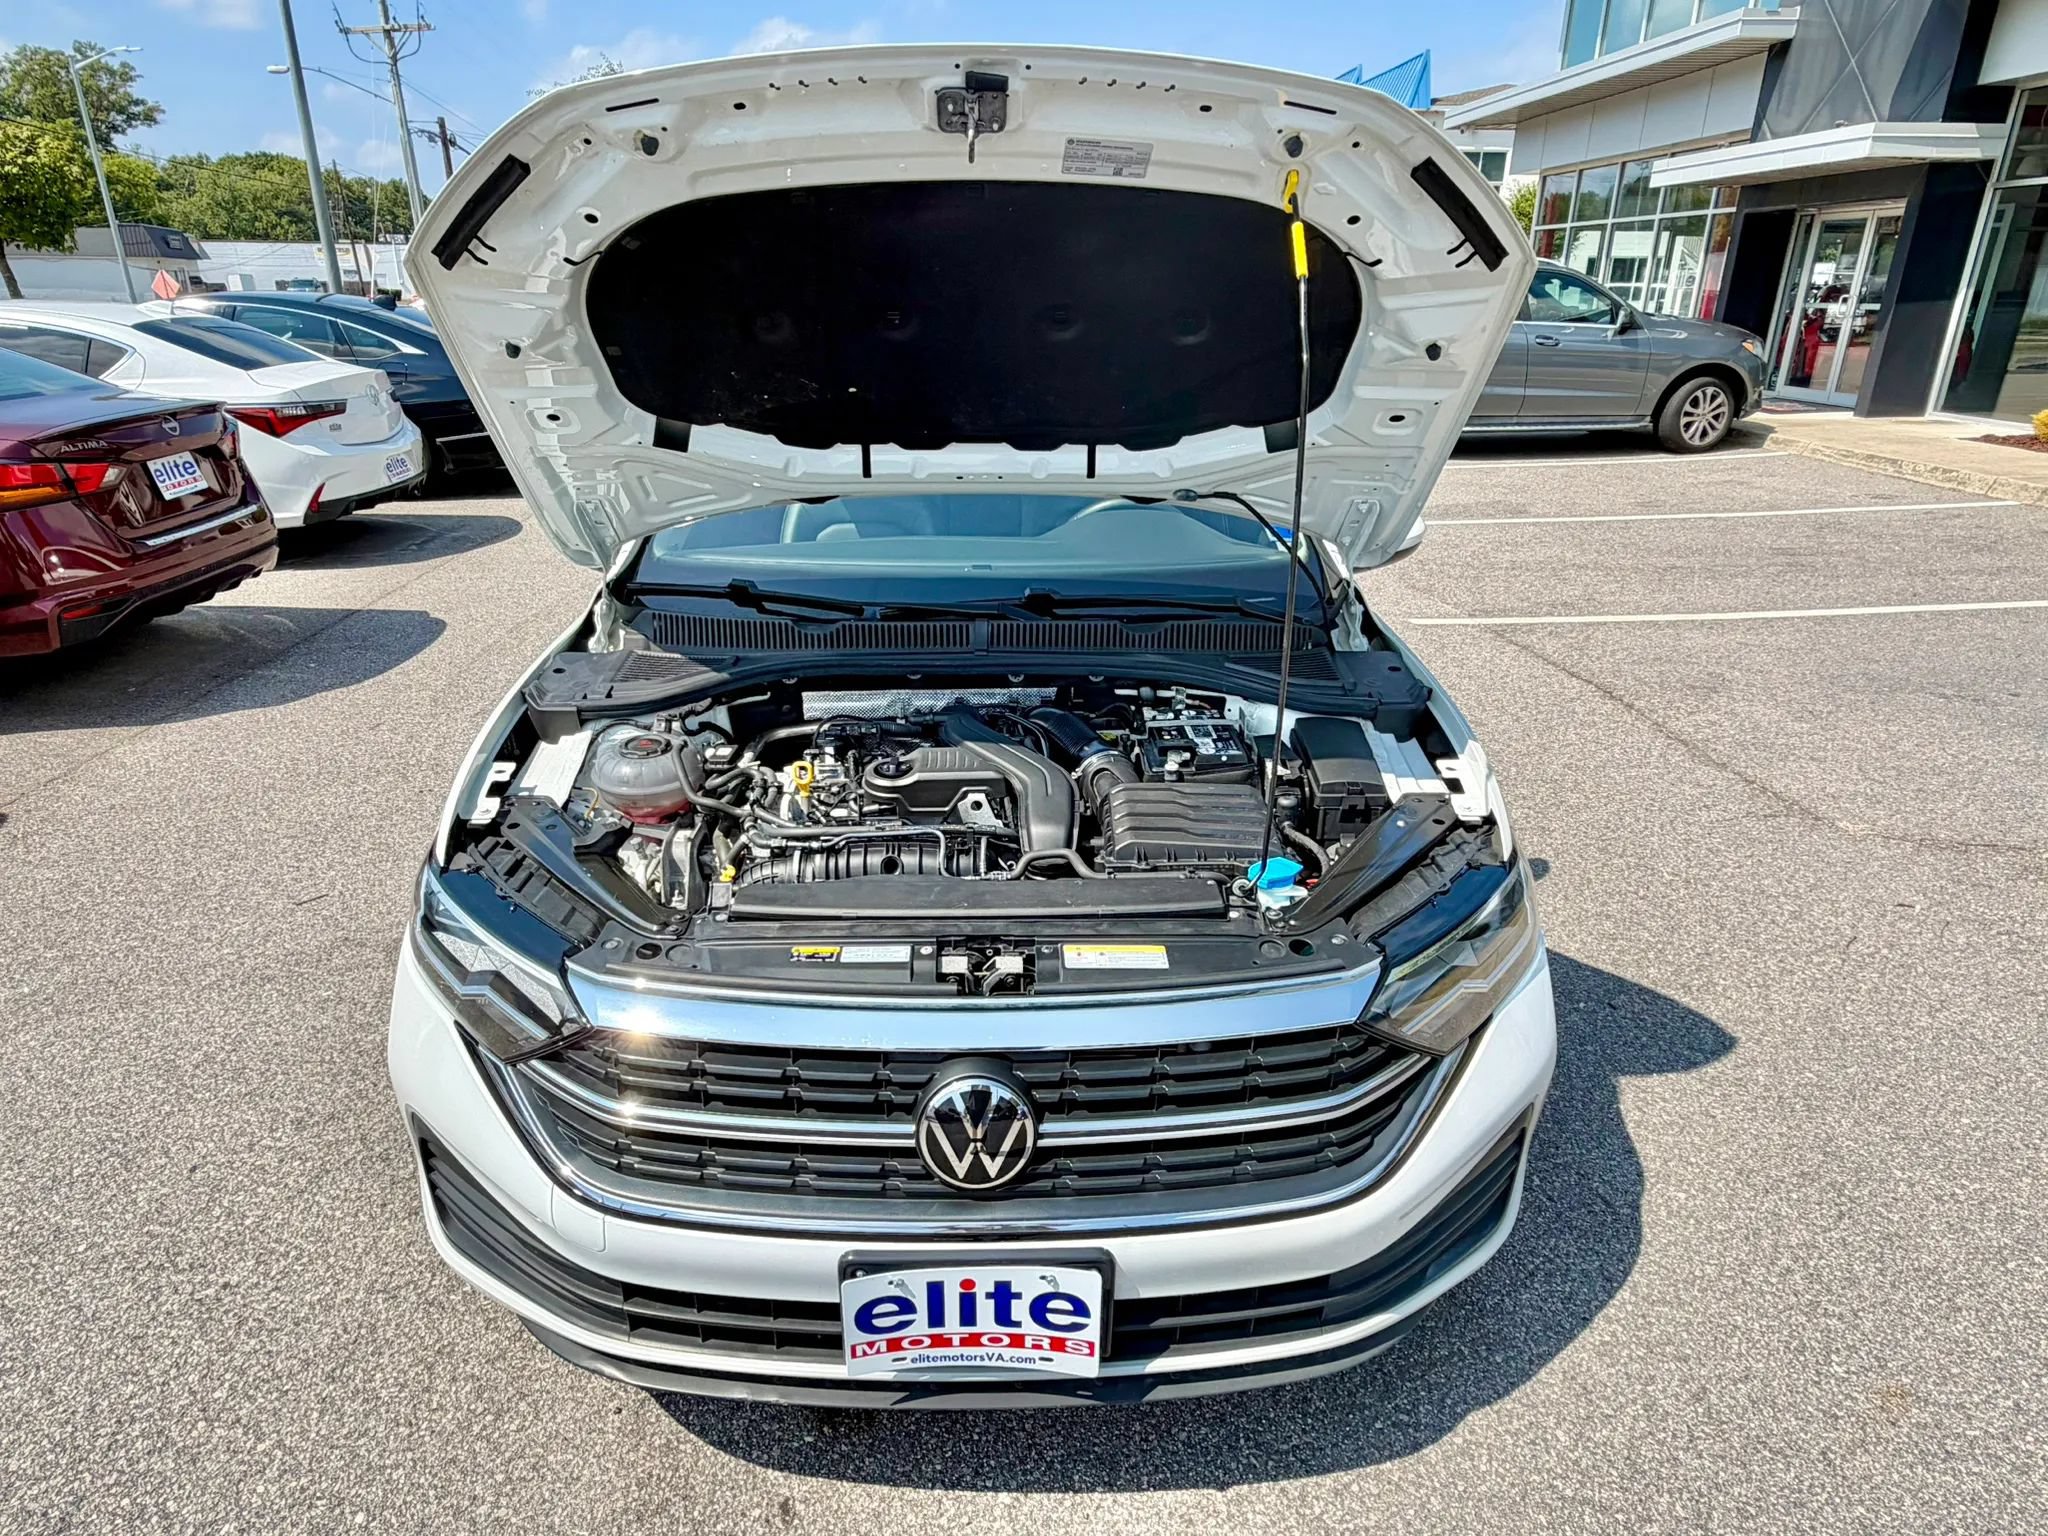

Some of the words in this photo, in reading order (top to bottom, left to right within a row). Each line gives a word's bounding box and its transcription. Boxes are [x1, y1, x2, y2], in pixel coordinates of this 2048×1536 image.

[60, 440, 109, 453] ALTIMA
[154, 460, 197, 483] elite
[386, 457, 408, 473] elite
[854, 1277, 1092, 1335] elite
[853, 1333, 1094, 1358] MOTORS
[910, 1351, 1036, 1365] elitemotorsVA.com
